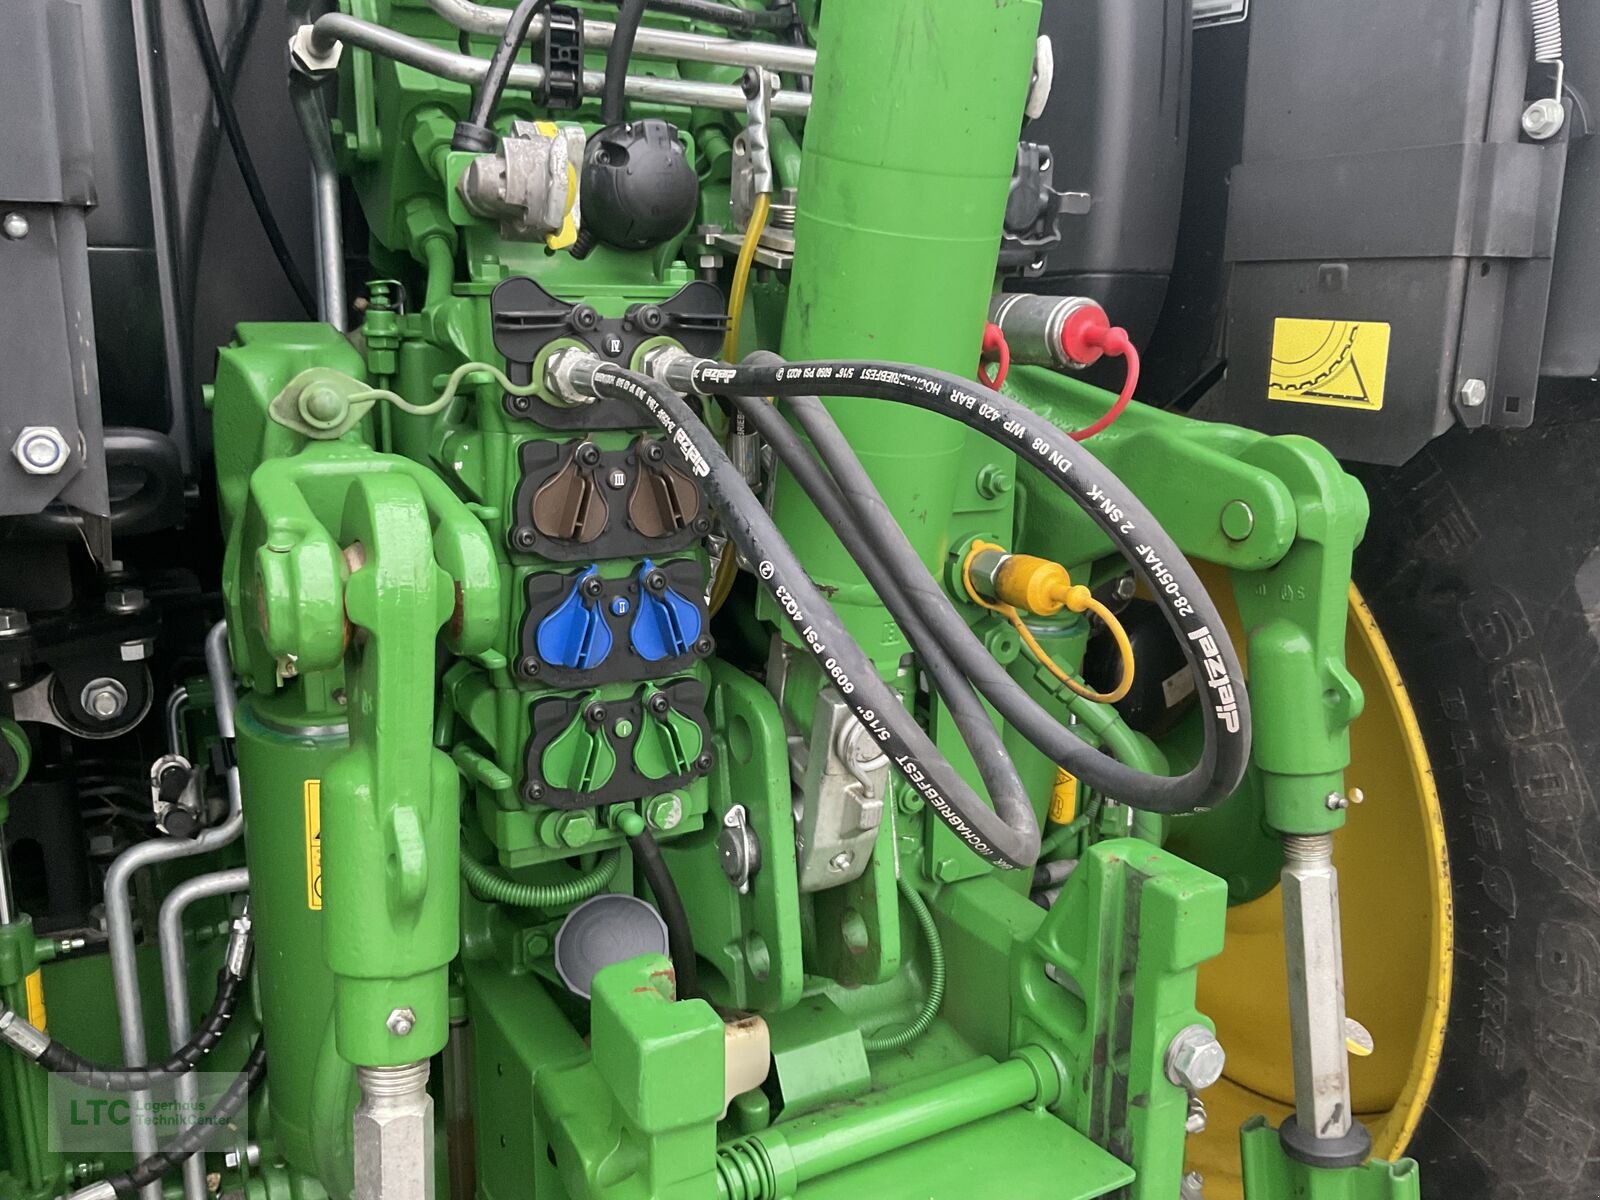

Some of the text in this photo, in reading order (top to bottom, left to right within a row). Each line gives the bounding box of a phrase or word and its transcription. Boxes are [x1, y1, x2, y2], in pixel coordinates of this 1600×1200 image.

[611, 339, 621, 353] IV
[701, 367, 737, 384] dietzel
[802, 367, 815, 379] PSI
[949, 388, 977, 410] BAR
[978, 403, 1001, 422] 420
[1003, 419, 1026, 439] WP
[673, 427, 711, 477] dietzel
[1031, 437, 1050, 455] 08
[1048, 450, 1073, 473] DN
[614, 473, 625, 486] III
[1086, 484, 1124, 523] SN-K
[1119, 520, 1136, 534] 2
[1135, 543, 1194, 617] 28-05HAF
[775, 585, 803, 622] 4Q23
[802, 625, 826, 654] PSI
[825, 658, 854, 694] 6090
[1187, 626, 1240, 733] dietzel
[856, 705, 891, 741] 5/16"
[895, 755, 994, 856] HOCHABRIEBFEST
